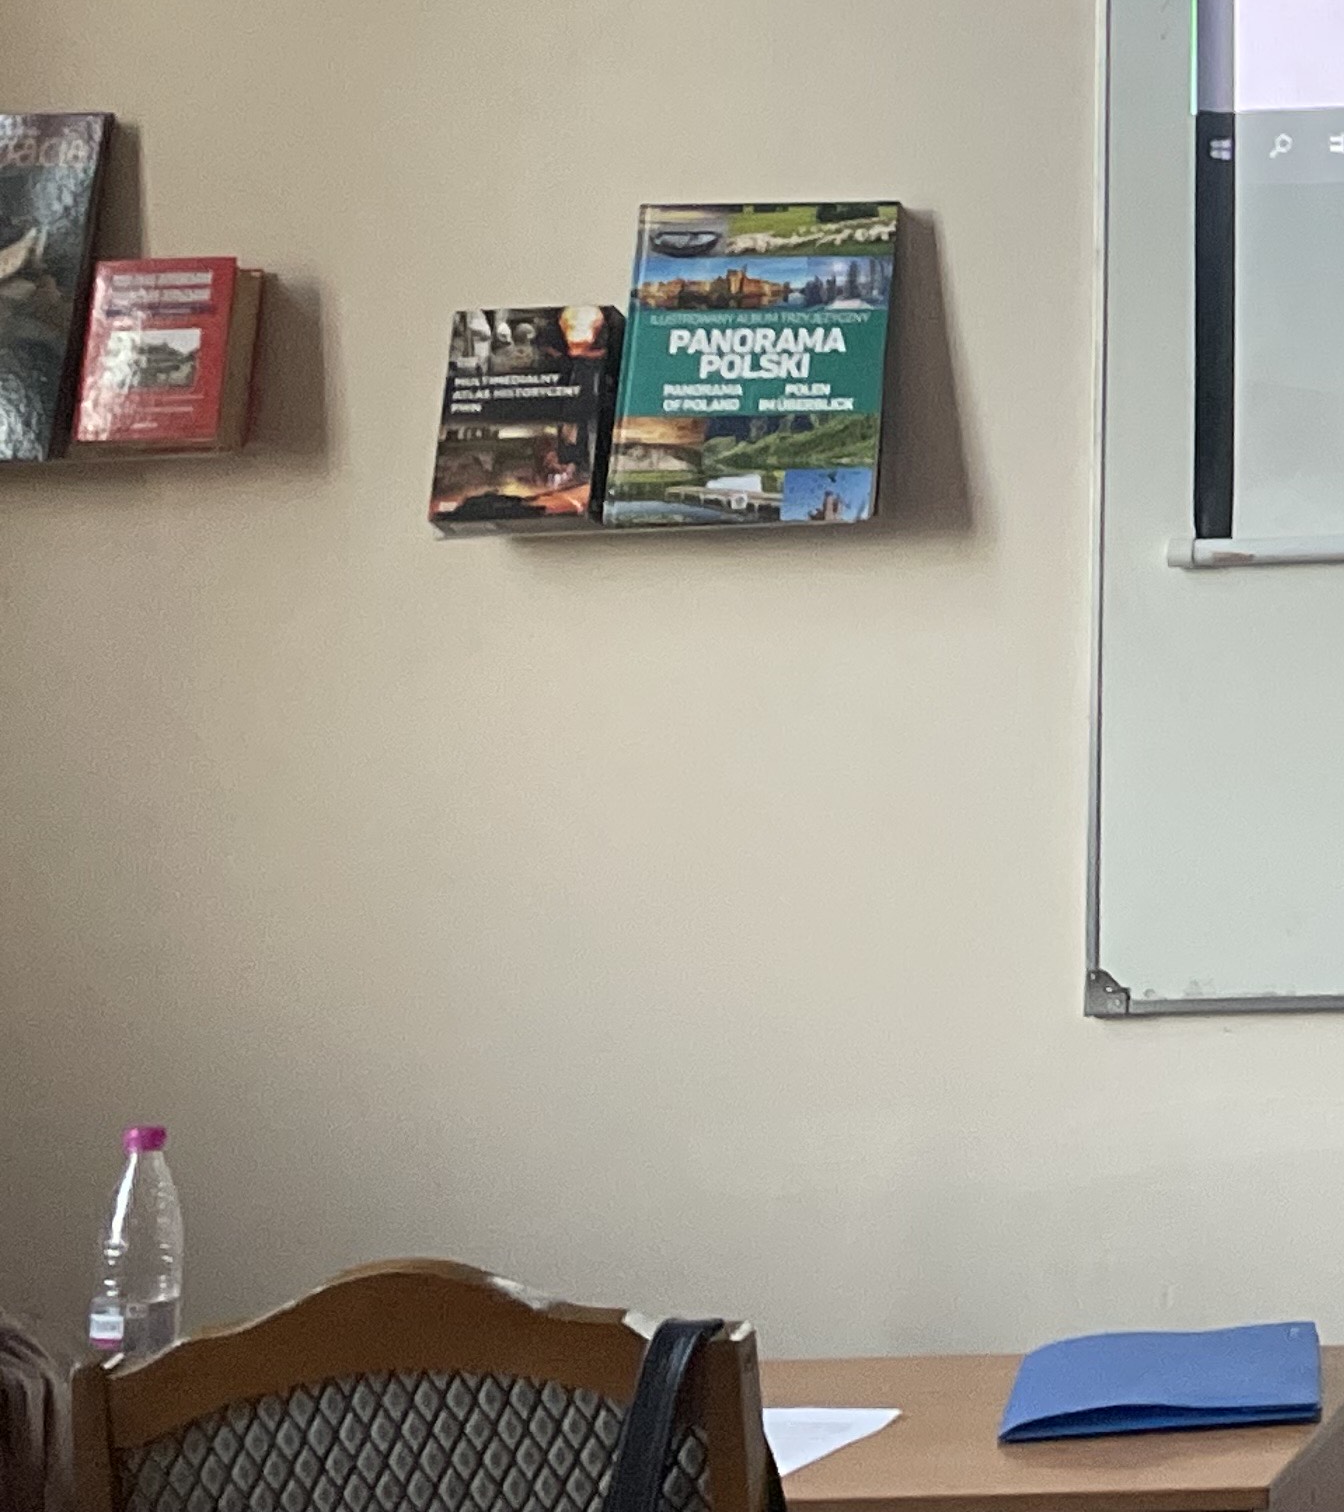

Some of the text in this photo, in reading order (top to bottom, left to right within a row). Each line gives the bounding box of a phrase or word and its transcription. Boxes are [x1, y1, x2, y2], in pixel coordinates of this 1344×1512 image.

[668, 327, 847, 355] PANORAMA
[699, 352, 811, 380] POLSKI
[451, 389, 491, 400] ATLAS
[784, 383, 831, 396] POLEN
[663, 398, 741, 412] OF POLAND
